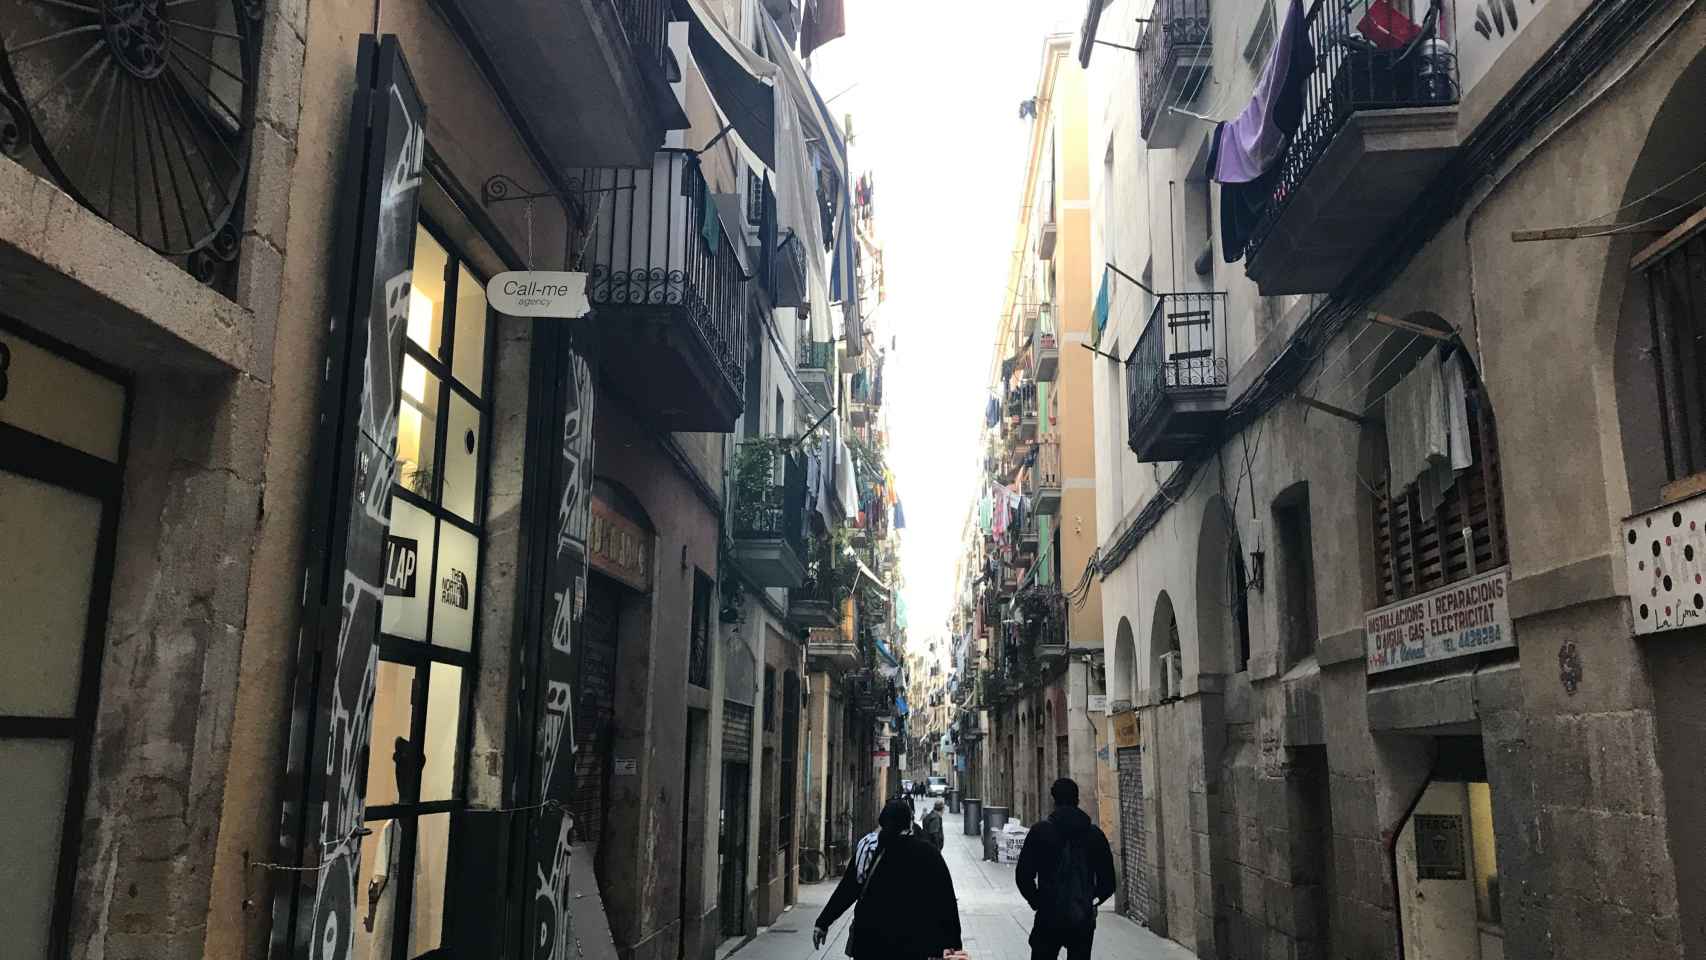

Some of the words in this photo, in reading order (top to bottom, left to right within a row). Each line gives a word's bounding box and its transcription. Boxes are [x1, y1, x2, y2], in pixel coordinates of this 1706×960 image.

[503, 280, 568, 296] Call-me
[517, 298, 552, 308] agency
[386, 541, 416, 590] LAP
[451, 567, 462, 582] THE
[442, 590, 462, 608] RAVAL
[1427, 600, 1431, 617] I
[1435, 578, 1504, 615] REPARACIONS
[1409, 622, 1425, 642] GAS
[1430, 602, 1495, 637] ELECTRICITAT
[1655, 608, 1672, 630] La
